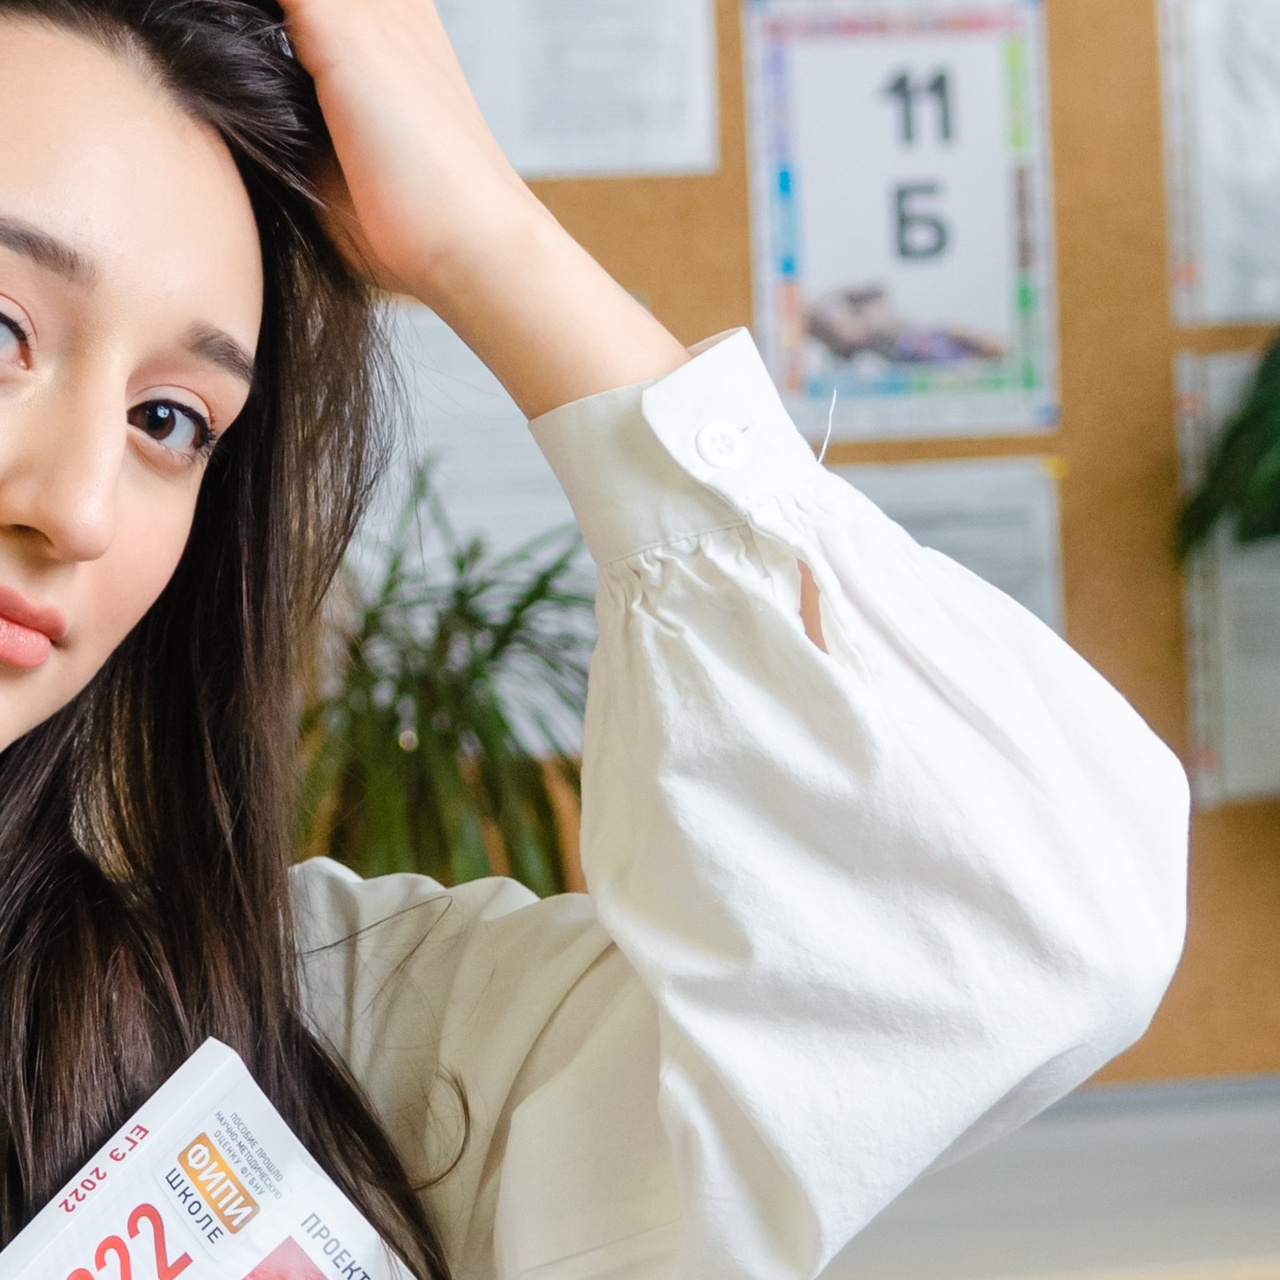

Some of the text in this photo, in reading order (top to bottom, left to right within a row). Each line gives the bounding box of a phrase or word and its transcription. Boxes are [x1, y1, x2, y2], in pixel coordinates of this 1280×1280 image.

[880, 68, 953, 144] 11
[892, 184, 950, 262] Б
[59, 1123, 150, 1214] ЕГЭ 2022
[185, 1142, 255, 1228] ФИПИ
[214, 1129, 265, 1196] ОЦЕНКУ ФГБНУ
[230, 1112, 284, 1183] ПОСОБИЕ ПРОШЛО
[164, 1166, 225, 1245] ШКОЛЕ
